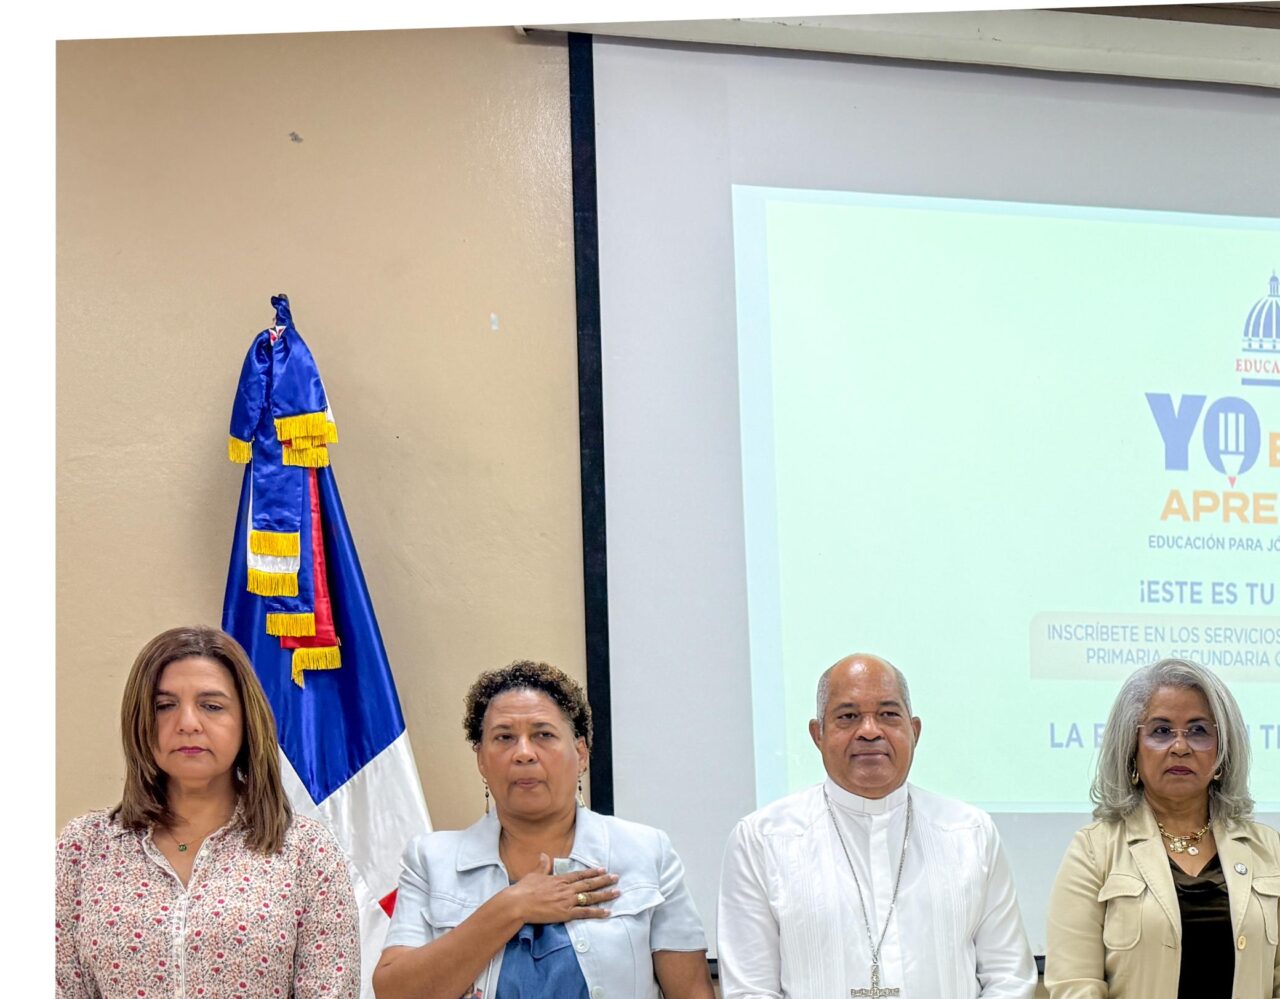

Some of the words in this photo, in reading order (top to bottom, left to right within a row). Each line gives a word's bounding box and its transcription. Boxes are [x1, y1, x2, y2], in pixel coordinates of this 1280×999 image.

[1144, 392, 1261, 477] YO
[1148, 534, 1225, 550] EDUCACIÓN
[1228, 537, 1263, 551] PARA
[1211, 582, 1238, 604] ES
[1246, 583, 1275, 605] TU
[1047, 622, 1139, 642] INSCRÍBETE
[1144, 626, 1165, 643] EN
[1170, 627, 1200, 643] LOS
[1050, 722, 1084, 748] LA
